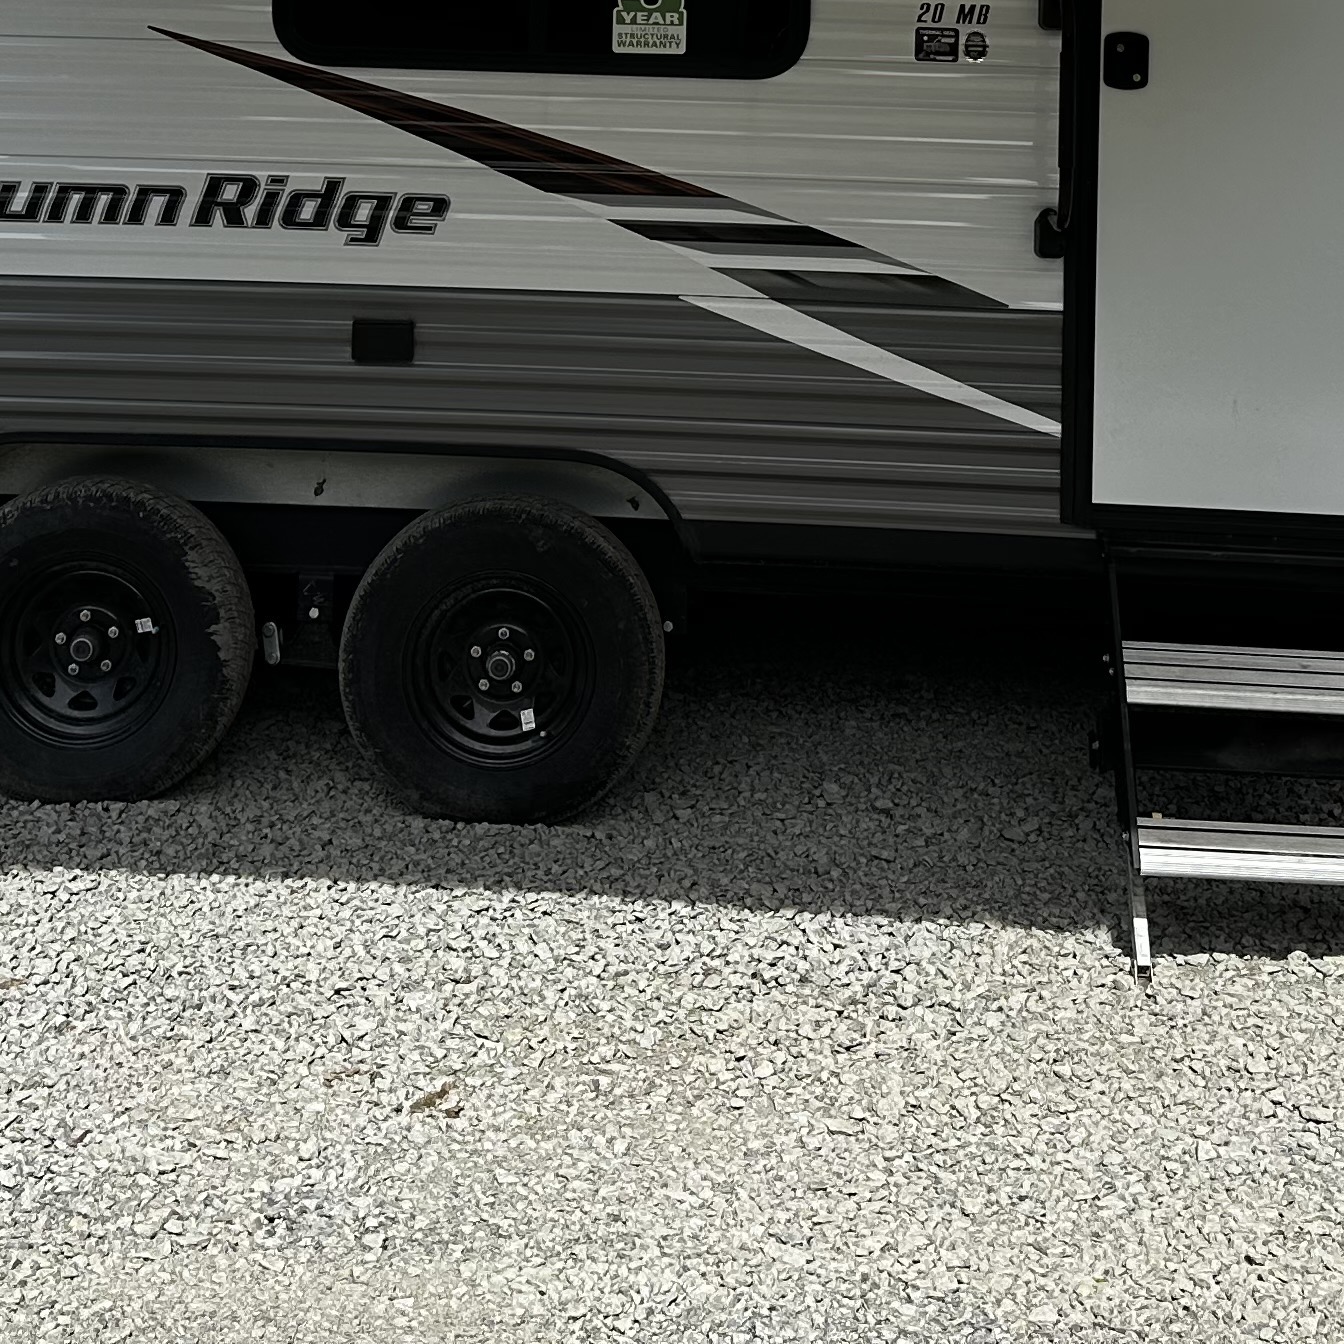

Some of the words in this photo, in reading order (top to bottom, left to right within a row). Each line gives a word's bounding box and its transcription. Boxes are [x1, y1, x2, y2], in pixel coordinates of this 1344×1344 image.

[620, 11, 680, 25] YEAR
[916, 2, 946, 24] 20
[955, 3, 991, 25] MB
[630, 26, 670, 34] LIMITED
[616, 32, 682, 41] STRUCTURAL
[616, 40, 682, 49] WARRANTY
[189, 172, 452, 247] Ridge
